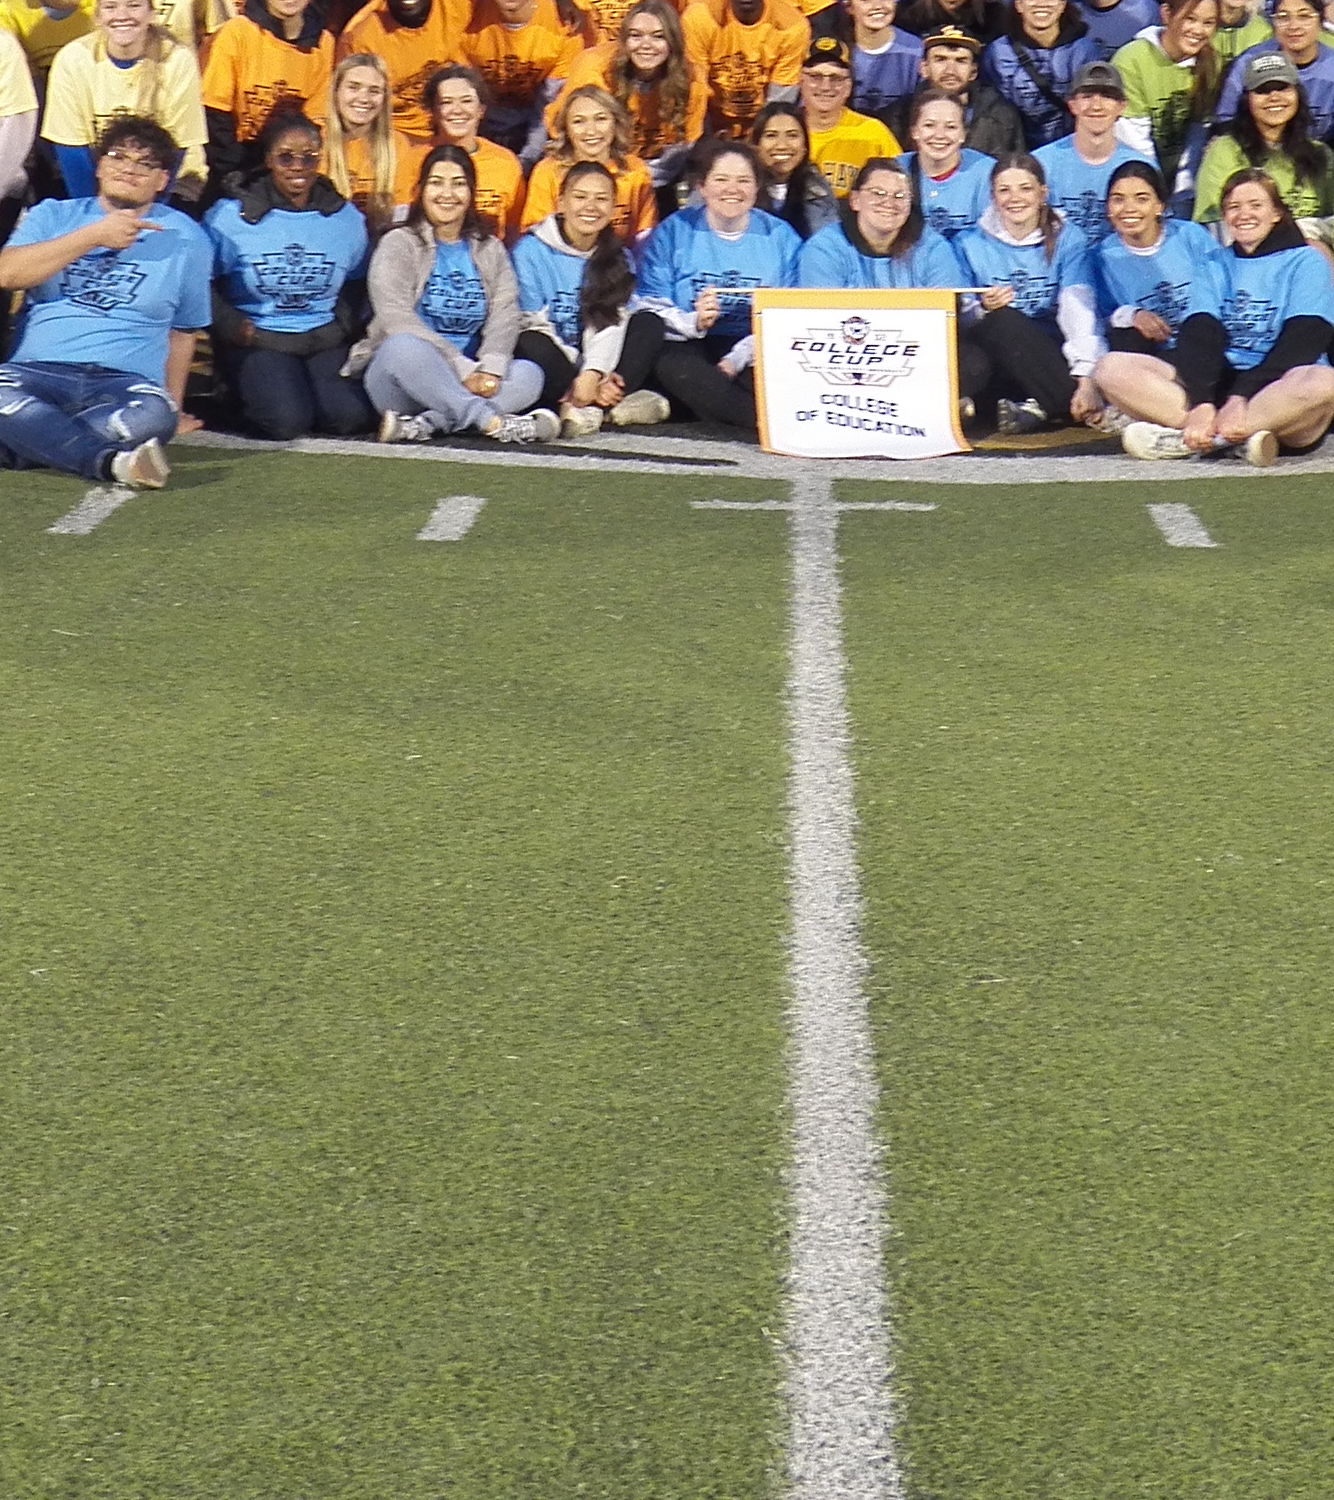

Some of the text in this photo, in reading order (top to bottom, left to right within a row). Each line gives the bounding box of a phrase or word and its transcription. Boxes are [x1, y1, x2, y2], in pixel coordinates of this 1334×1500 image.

[791, 341, 920, 356] COLLEGE
[829, 355, 884, 365] CUP
[820, 394, 899, 418] COLLEGE
[796, 410, 927, 437] OF EDUCATION
